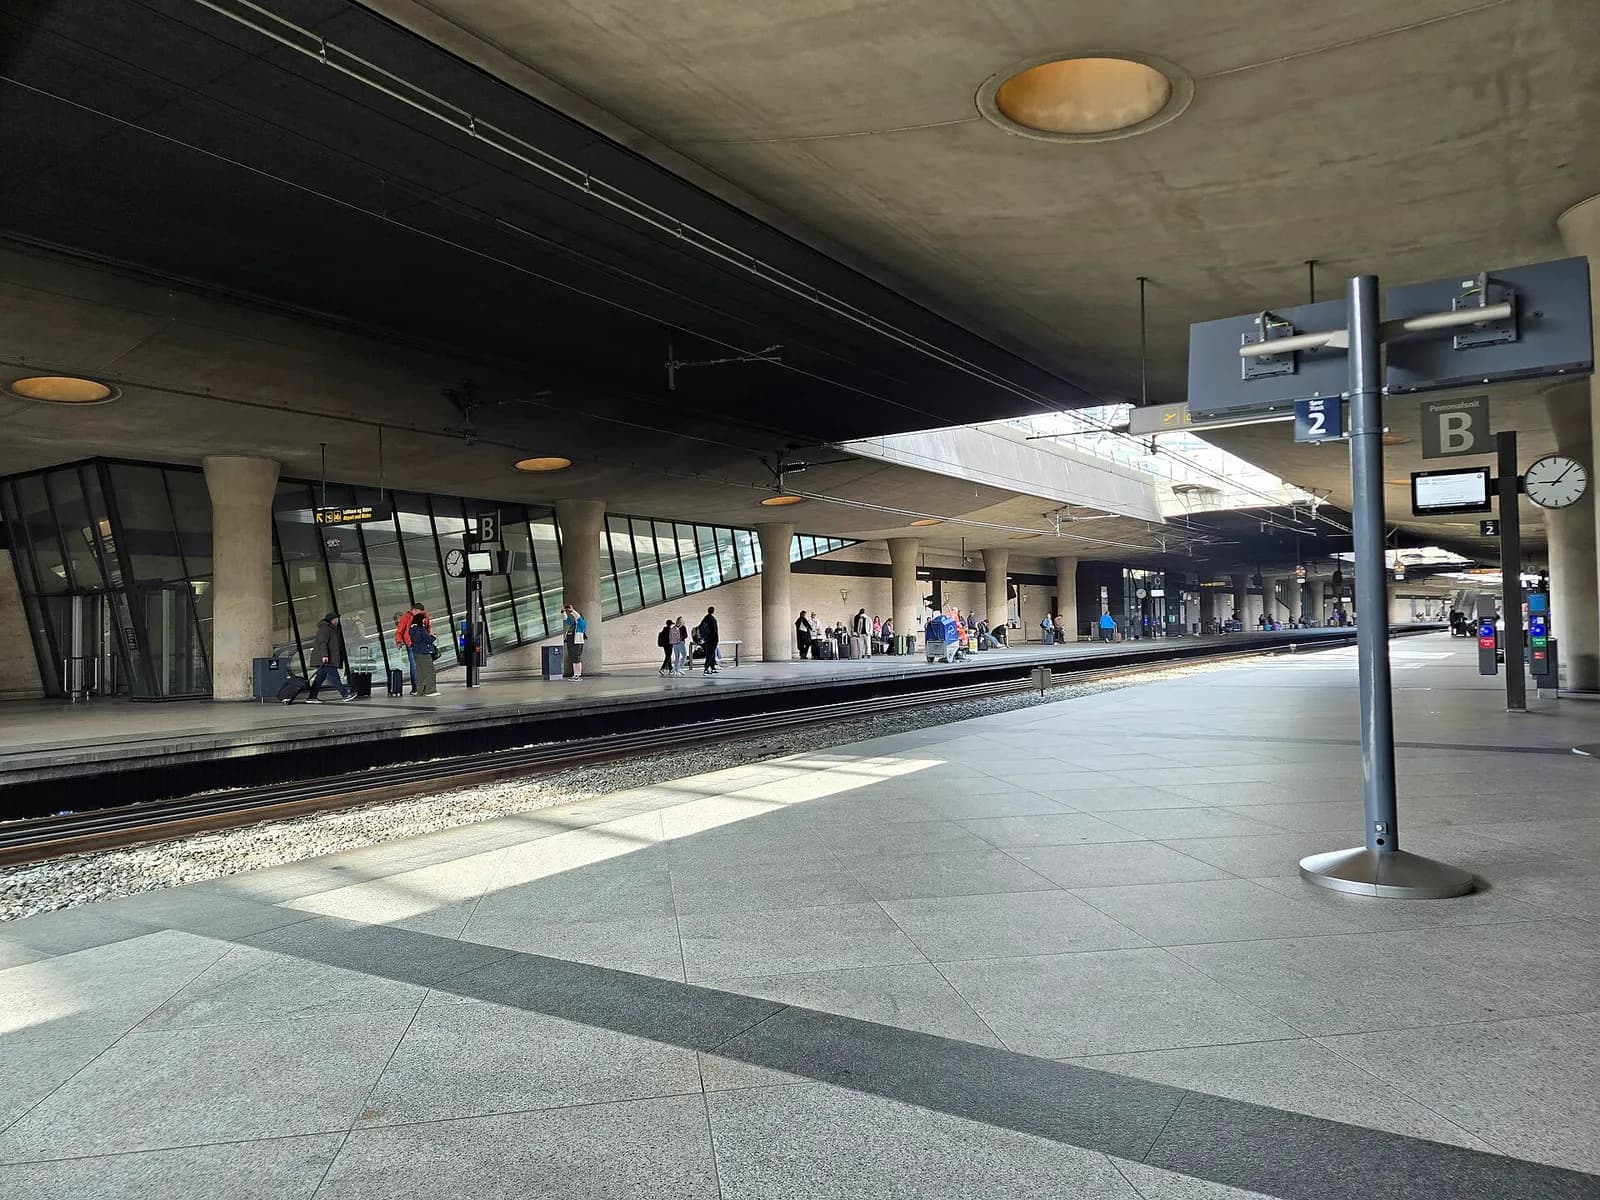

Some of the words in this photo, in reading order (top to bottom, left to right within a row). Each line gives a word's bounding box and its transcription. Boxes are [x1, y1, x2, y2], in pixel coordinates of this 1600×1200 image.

[1308, 412, 1326, 435] 2
[1440, 412, 1474, 453] B
[481, 517, 495, 541] B
[1485, 525, 1495, 535] 2
